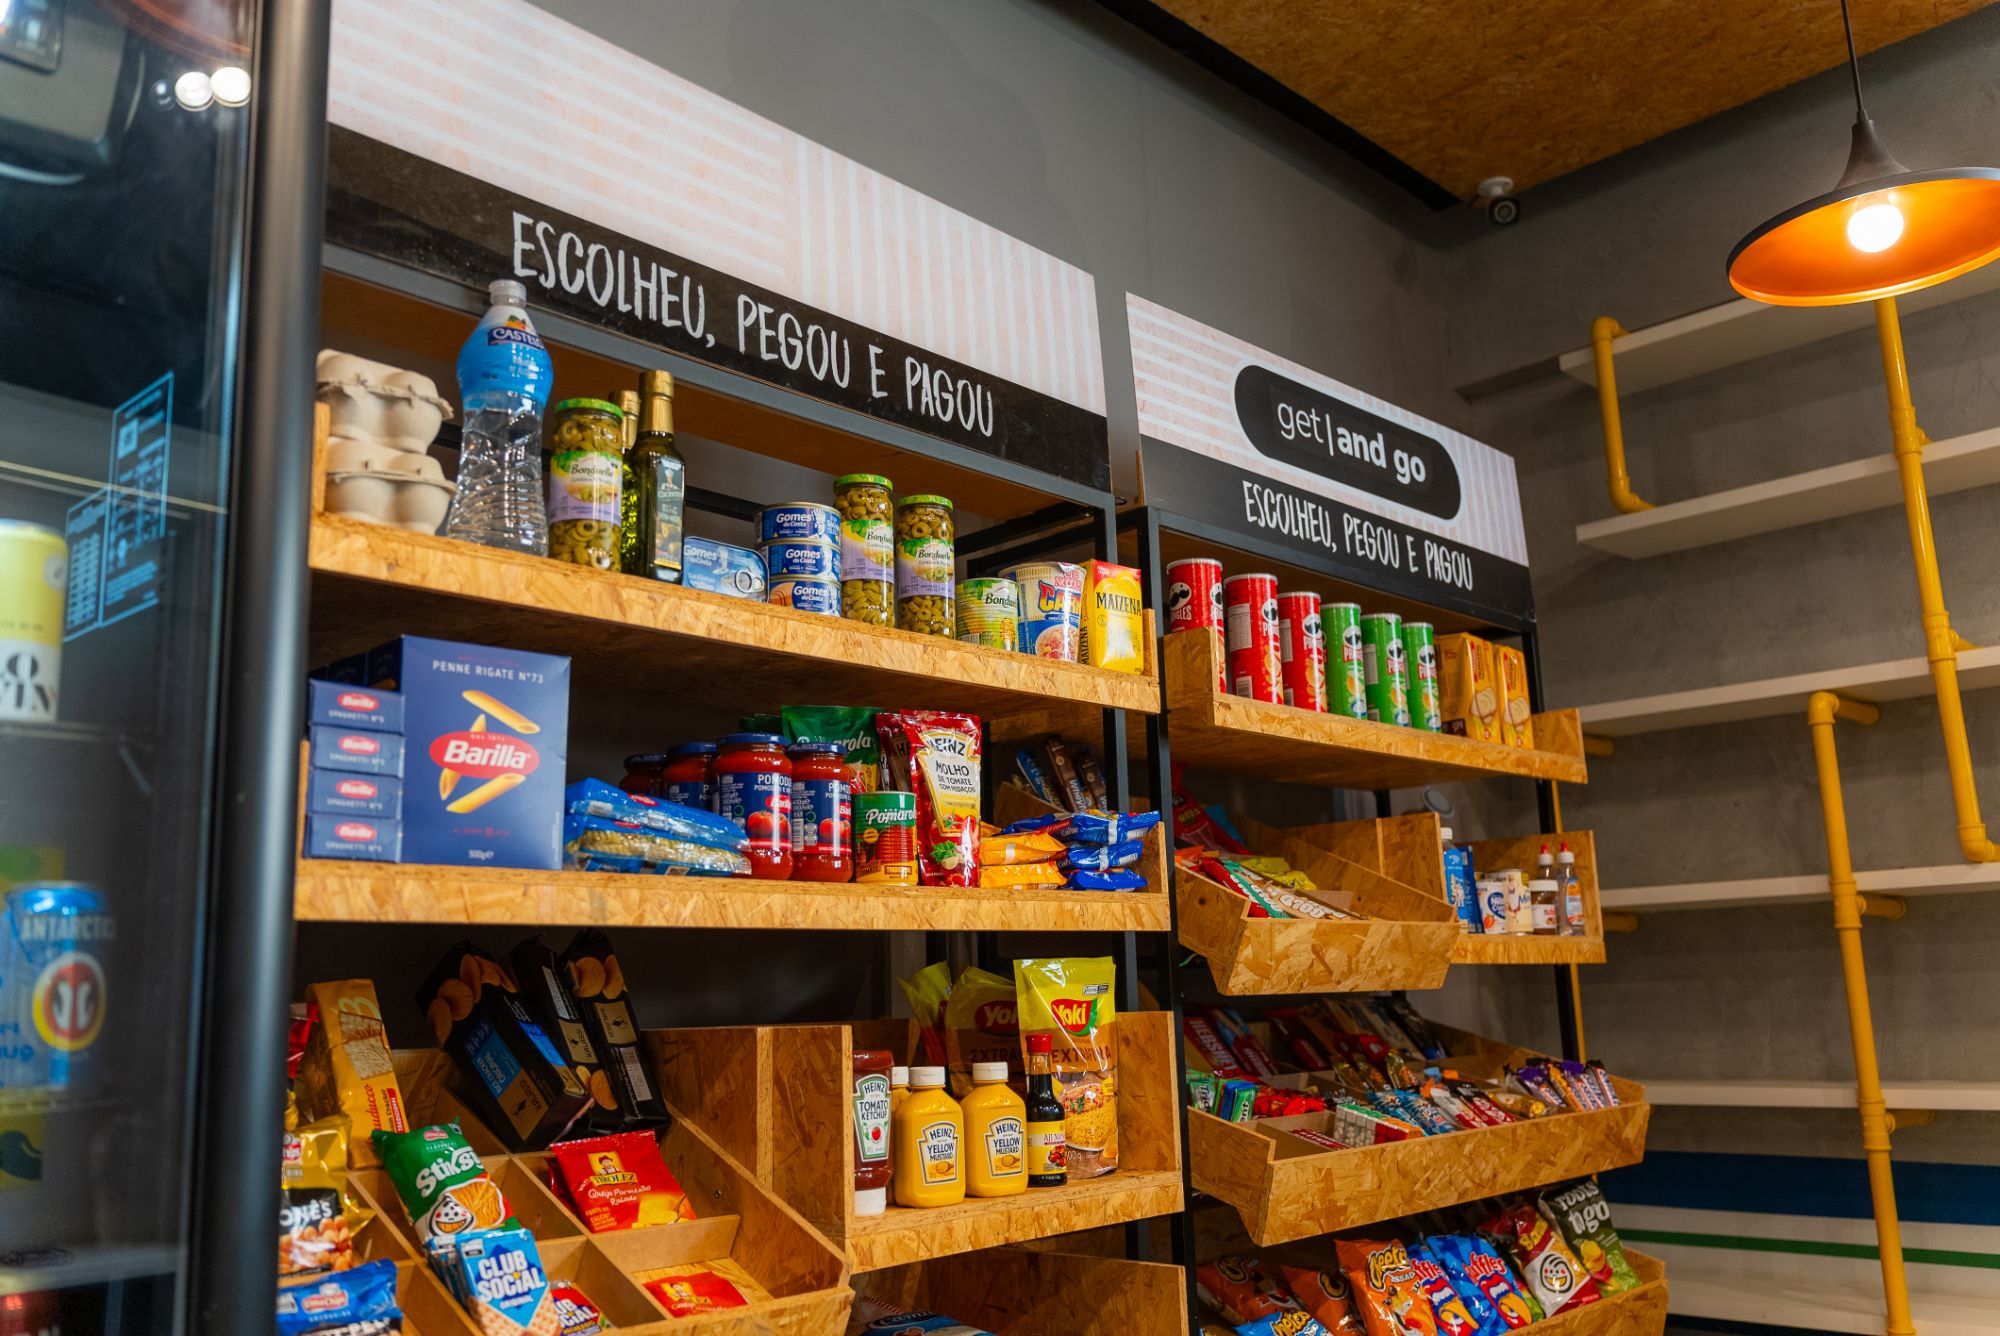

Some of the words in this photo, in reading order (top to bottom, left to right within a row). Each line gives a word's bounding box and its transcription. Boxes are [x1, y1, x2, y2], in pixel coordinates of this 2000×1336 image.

[512, 211, 715, 349] ESCOLHEU,
[738, 294, 850, 389] PEGOU
[869, 343, 888, 398] E
[905, 356, 993, 437] PAGOU
[1393, 449, 1426, 484] go
[776, 513, 811, 523] Gomes
[1242, 480, 1337, 553] ESCOLHEU,
[1343, 512, 1400, 569] PEGOU
[1406, 535, 1418, 573] E
[1424, 540, 1473, 591] PAGOU
[684, 545, 718, 561] Gomes
[786, 548, 821, 559] Gomes
[794, 585, 827, 596] Gomes
[1038, 580, 1082, 613] CAR
[985, 593, 1017, 609] Bondu
[1096, 591, 1142, 617] MAIZENA
[432, 660, 471, 675] PENNE
[475, 666, 514, 681] RIGATE
[444, 740, 527, 769] Barilla
[936, 760, 970, 776] MOLHO
[946, 777, 972, 786] TOMATE
[983, 1006, 1018, 1027] Yok
[1053, 1003, 1086, 1028] Yoki
[864, 1083, 885, 1094] HEINZ
[859, 1100, 888, 1111] TOMATO
[1200, 1085, 1210, 1111] Trid
[861, 1110, 887, 1120] KETCHUP
[930, 1128, 953, 1140] HEINZ
[995, 1123, 1018, 1134] HEINZ
[926, 1143, 954, 1154] YELLOW
[993, 1138, 1020, 1149] YELLOW
[995, 1146, 1020, 1156] MUSTARD
[930, 1152, 953, 1162] MUSTARD
[280, 1200, 333, 1227] ONÊS
[478, 1250, 528, 1280] CLUB
